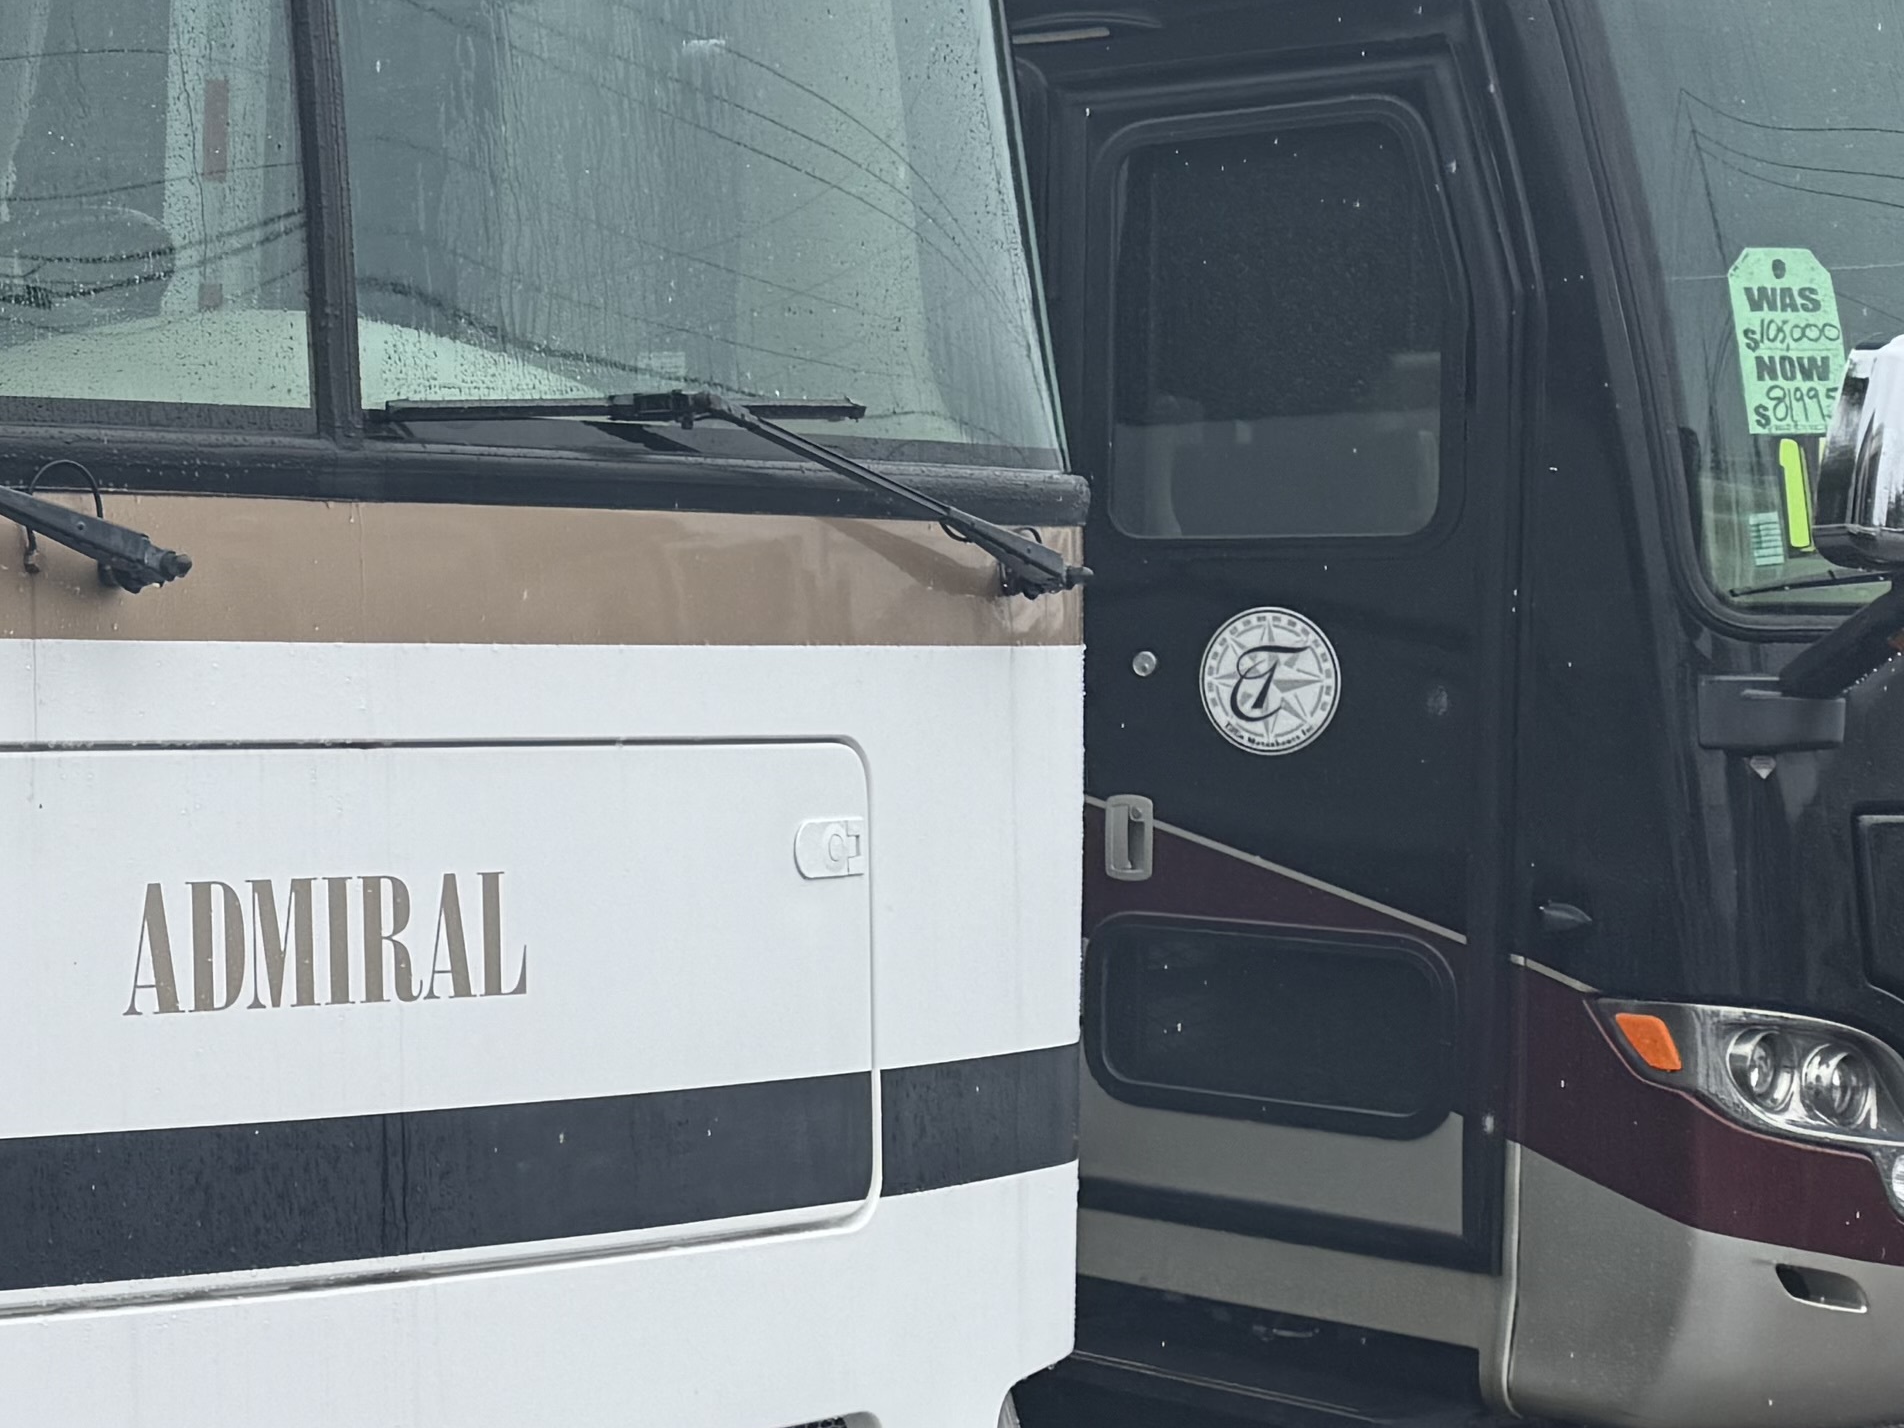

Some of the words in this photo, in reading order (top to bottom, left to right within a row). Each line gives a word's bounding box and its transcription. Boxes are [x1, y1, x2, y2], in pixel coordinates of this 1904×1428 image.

[1743, 286, 1822, 313] WAS
[1754, 357, 1831, 382] NOW
[122, 871, 527, 1016] ADMIRAL
